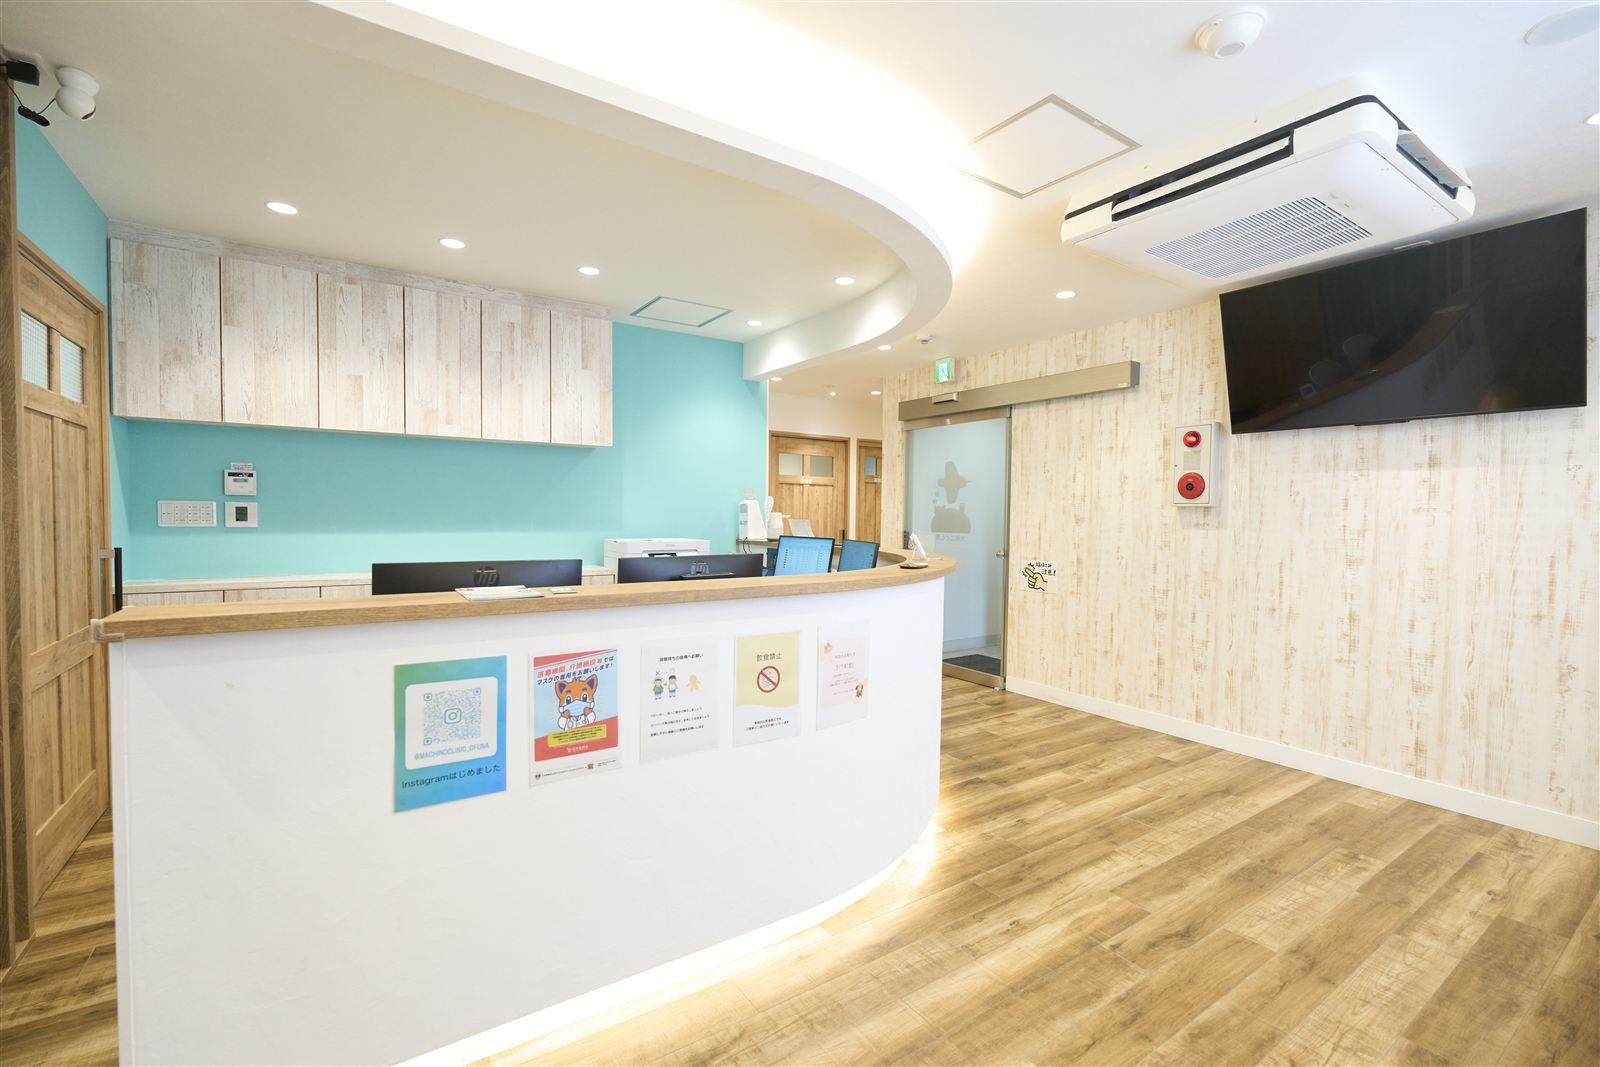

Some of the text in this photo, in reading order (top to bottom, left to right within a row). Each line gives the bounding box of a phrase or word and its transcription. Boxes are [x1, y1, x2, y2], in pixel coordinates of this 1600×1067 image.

[756, 652, 783, 662] 飲食禁止
[401, 764, 501, 789] Instagramはじめました
